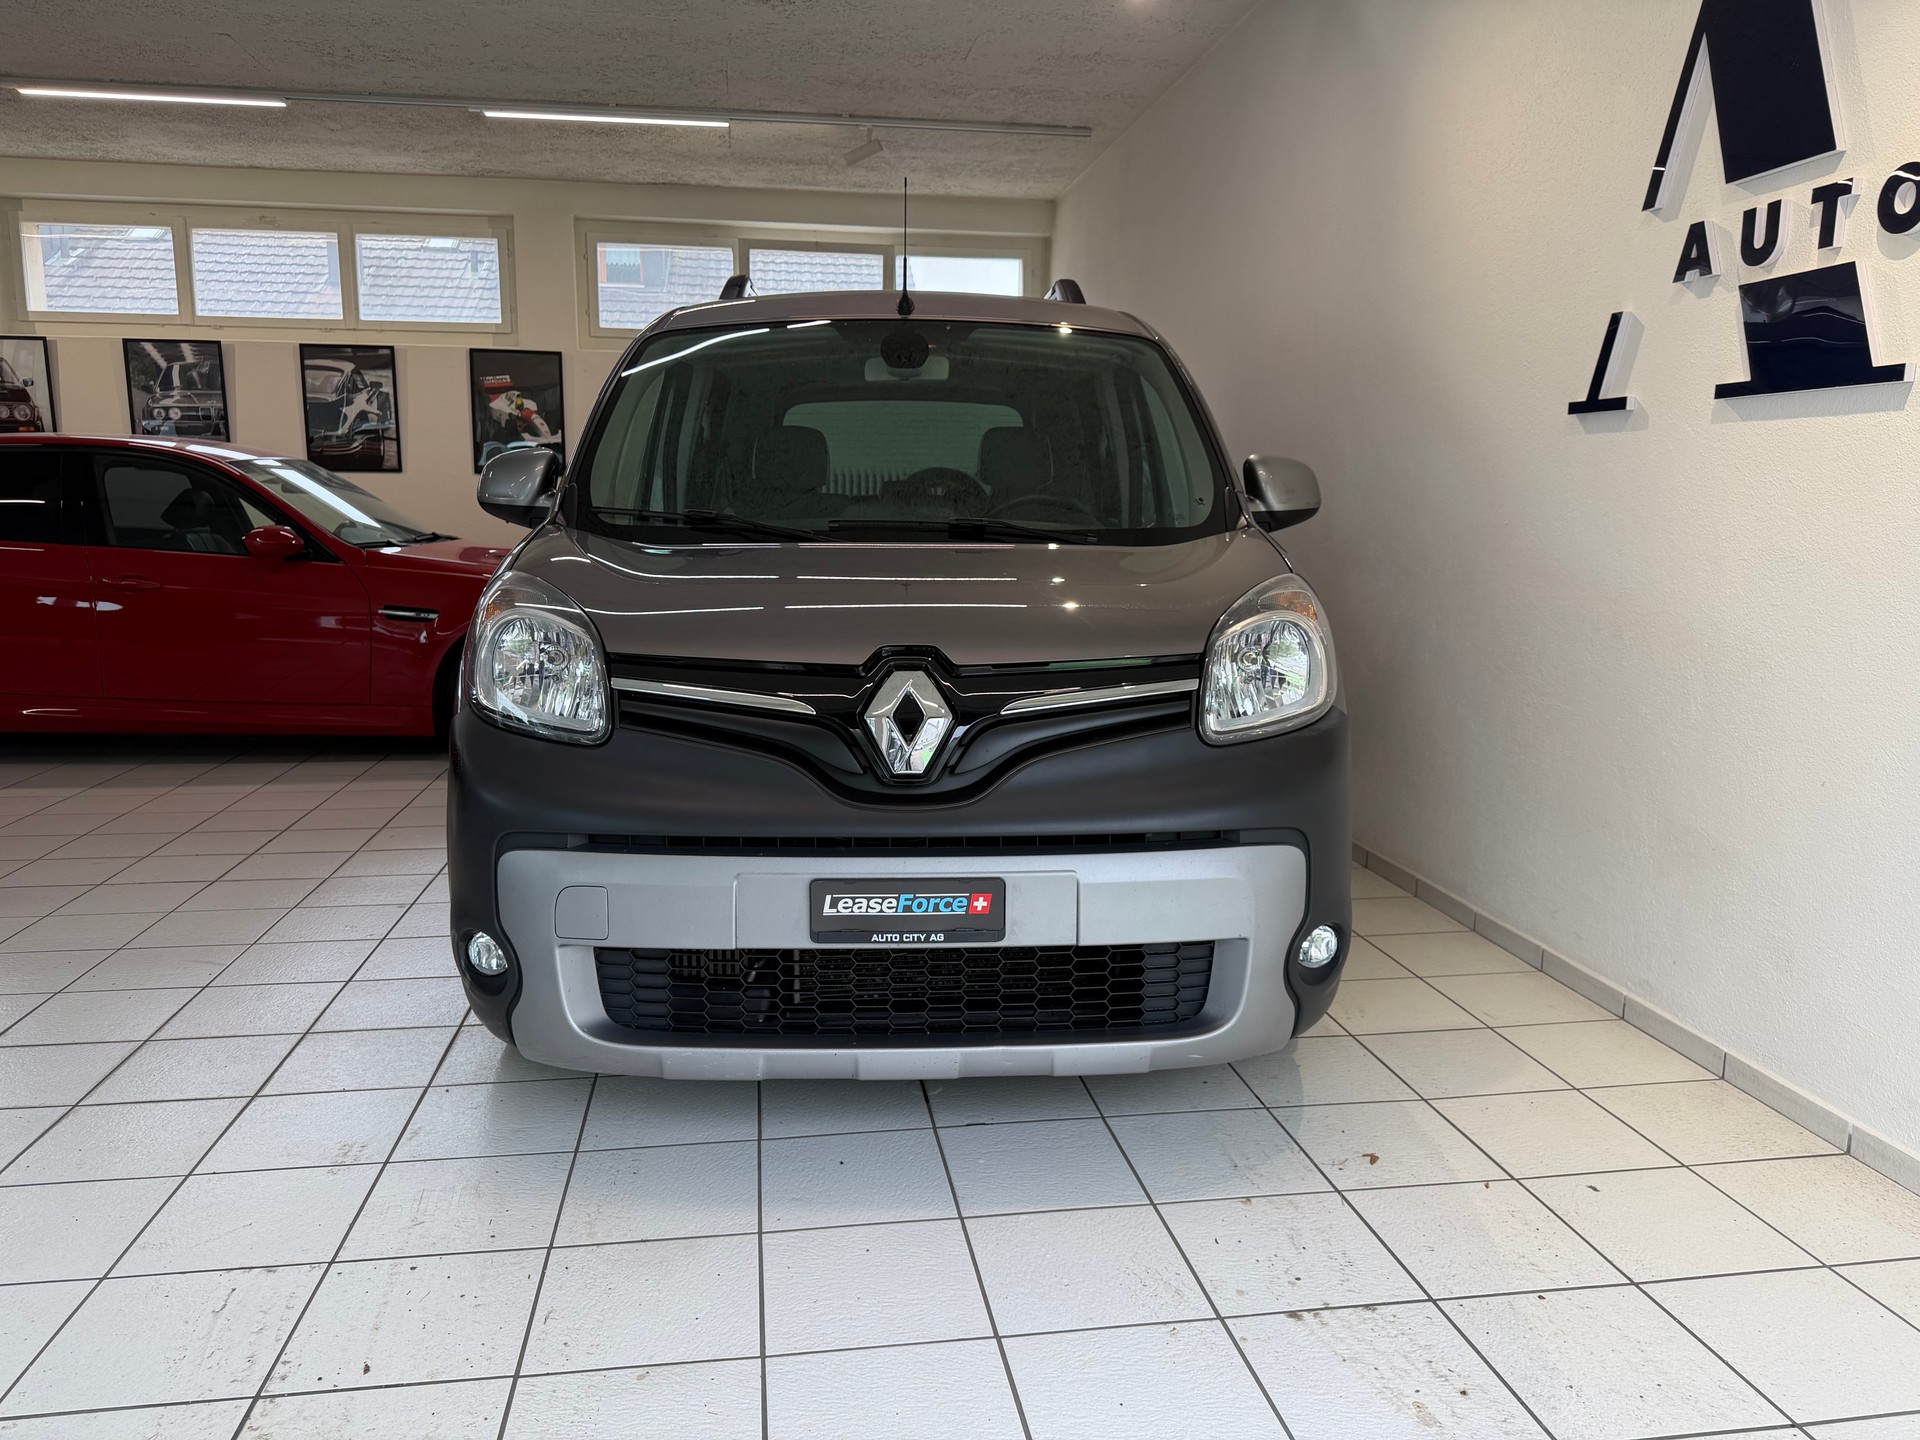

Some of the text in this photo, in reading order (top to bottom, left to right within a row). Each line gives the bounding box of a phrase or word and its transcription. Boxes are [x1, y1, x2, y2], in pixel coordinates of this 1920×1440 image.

[1672, 160, 1920, 284] AUTO
[822, 894, 968, 914] LeaseForce
[871, 933, 945, 942] AUTO CITY AG
